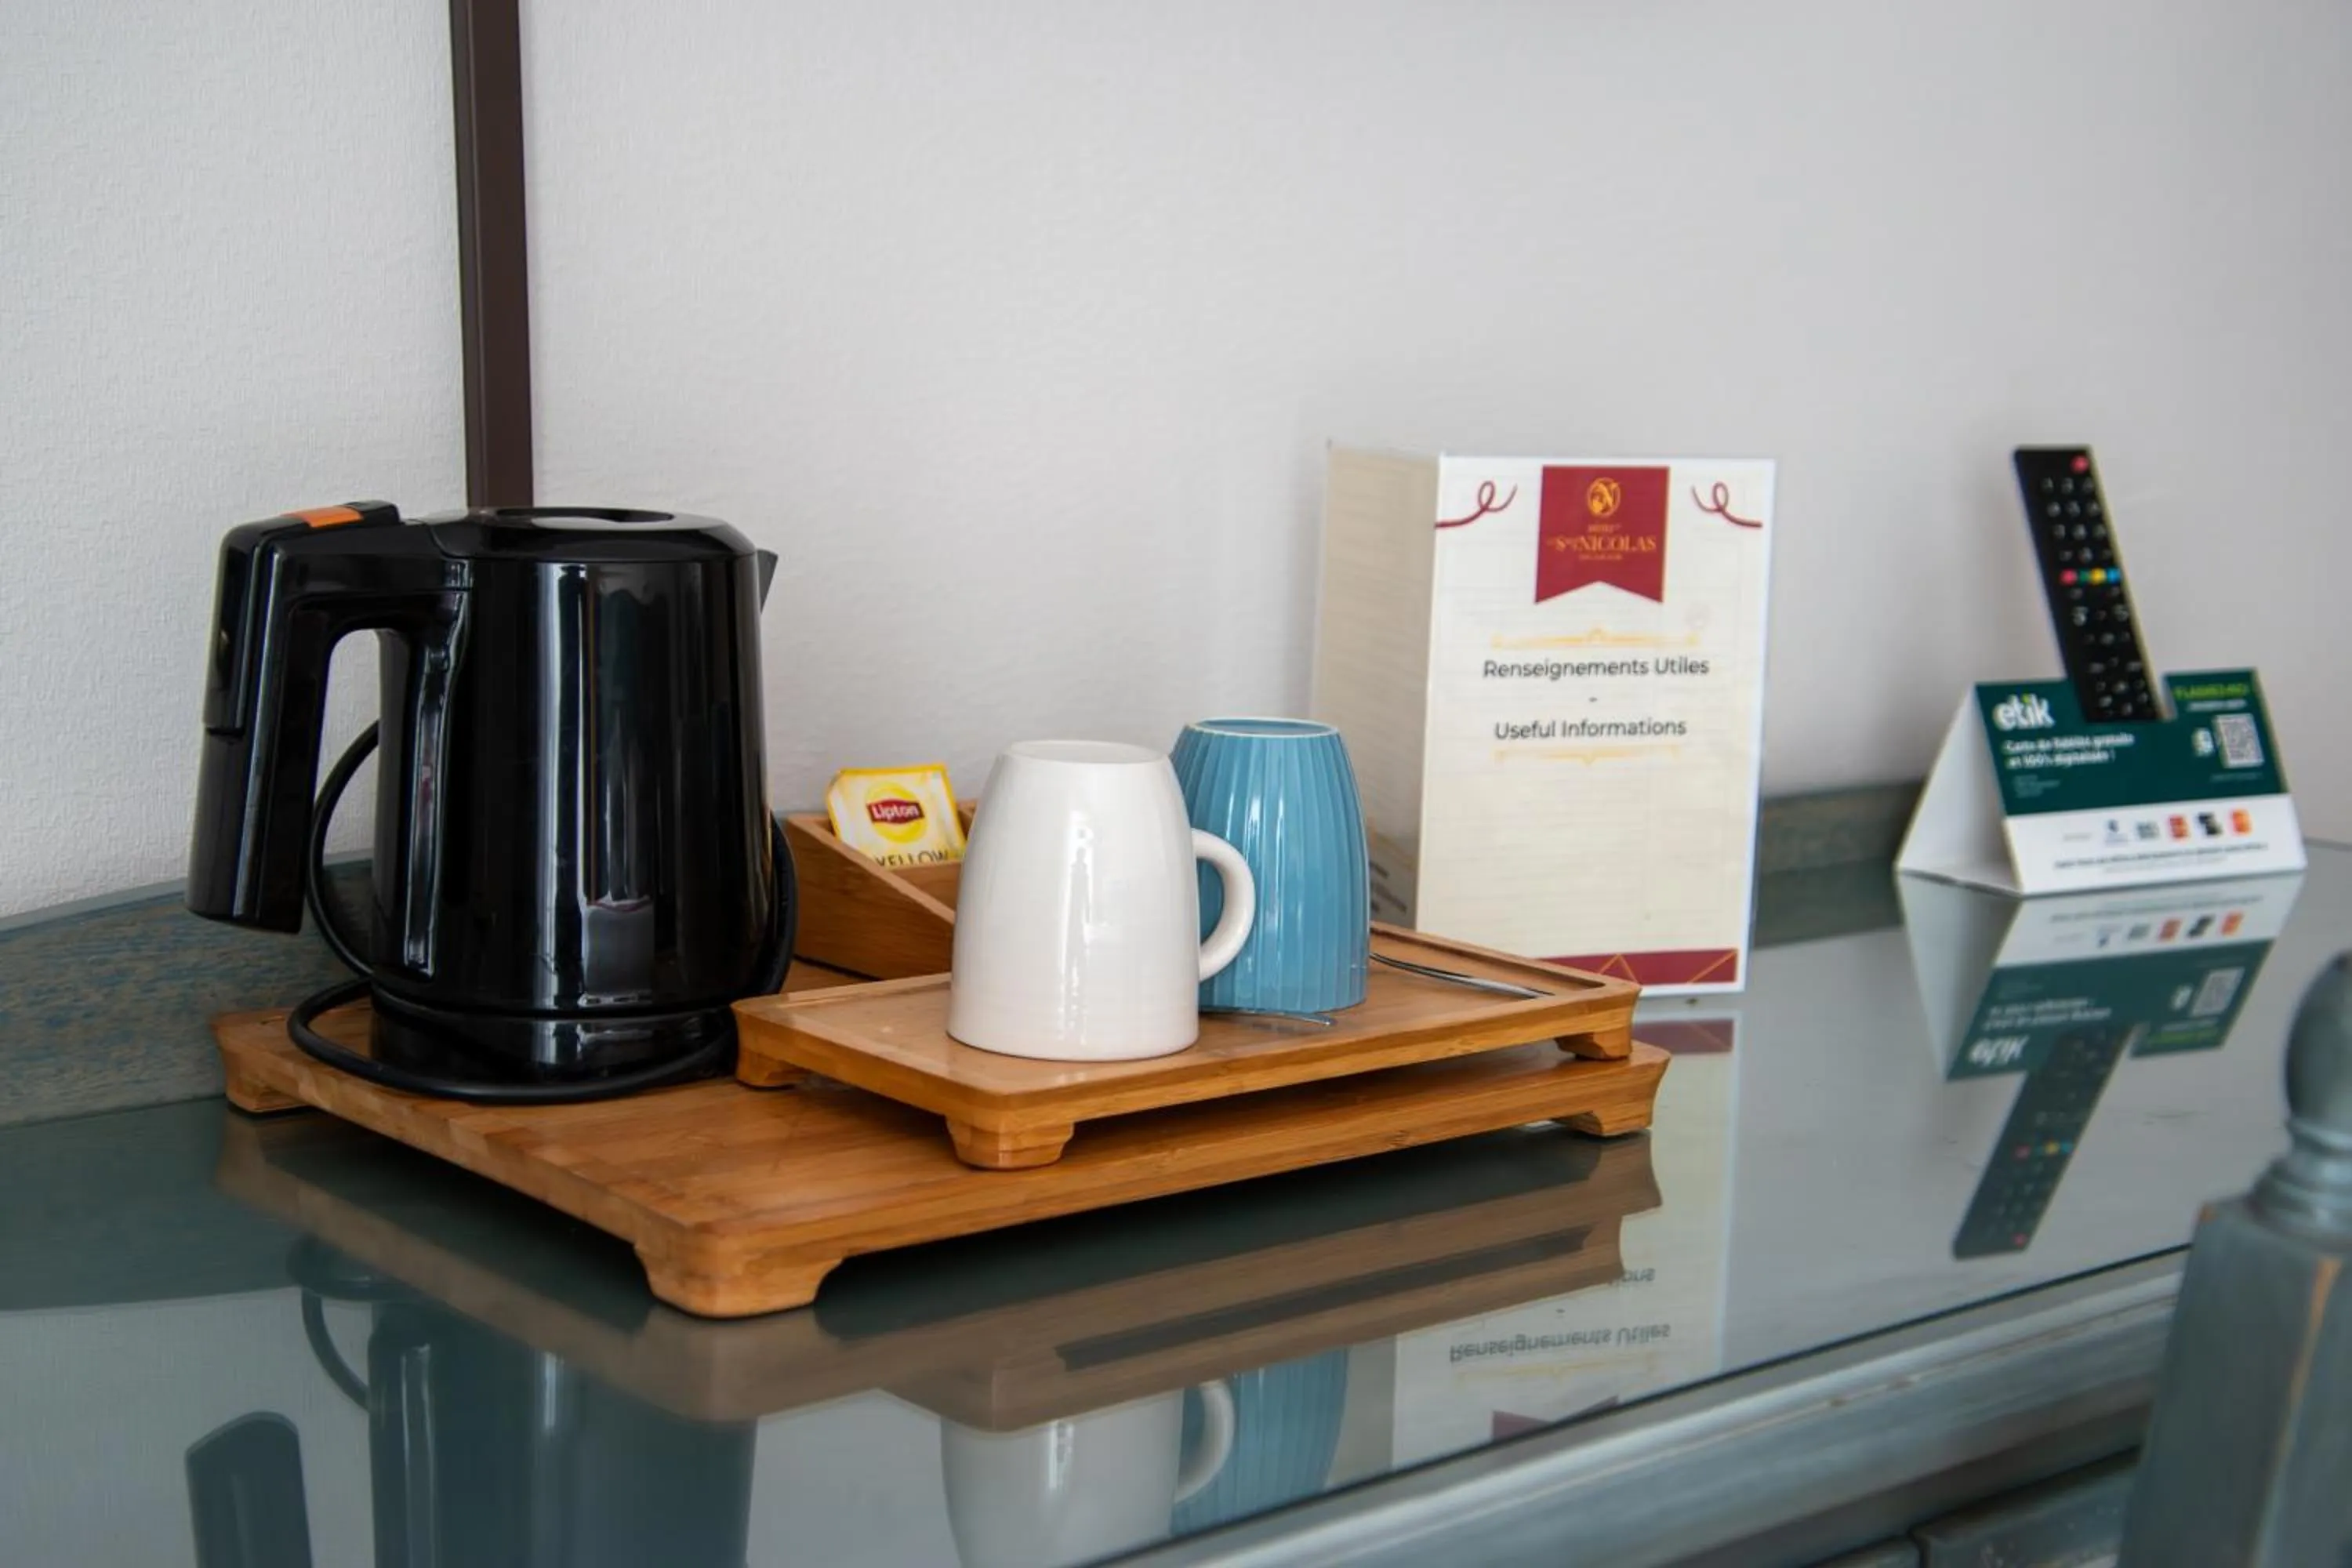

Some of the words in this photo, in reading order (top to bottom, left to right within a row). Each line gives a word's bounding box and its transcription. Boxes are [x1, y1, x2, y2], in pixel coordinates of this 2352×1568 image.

[1483, 659, 1650, 681] Renseignements
[1654, 656, 1710, 675] Utiles
[1992, 693, 2056, 731] etik
[1494, 719, 1556, 740] Useful
[1561, 717, 1687, 738] Informations
[872, 803, 920, 822] Lipton
